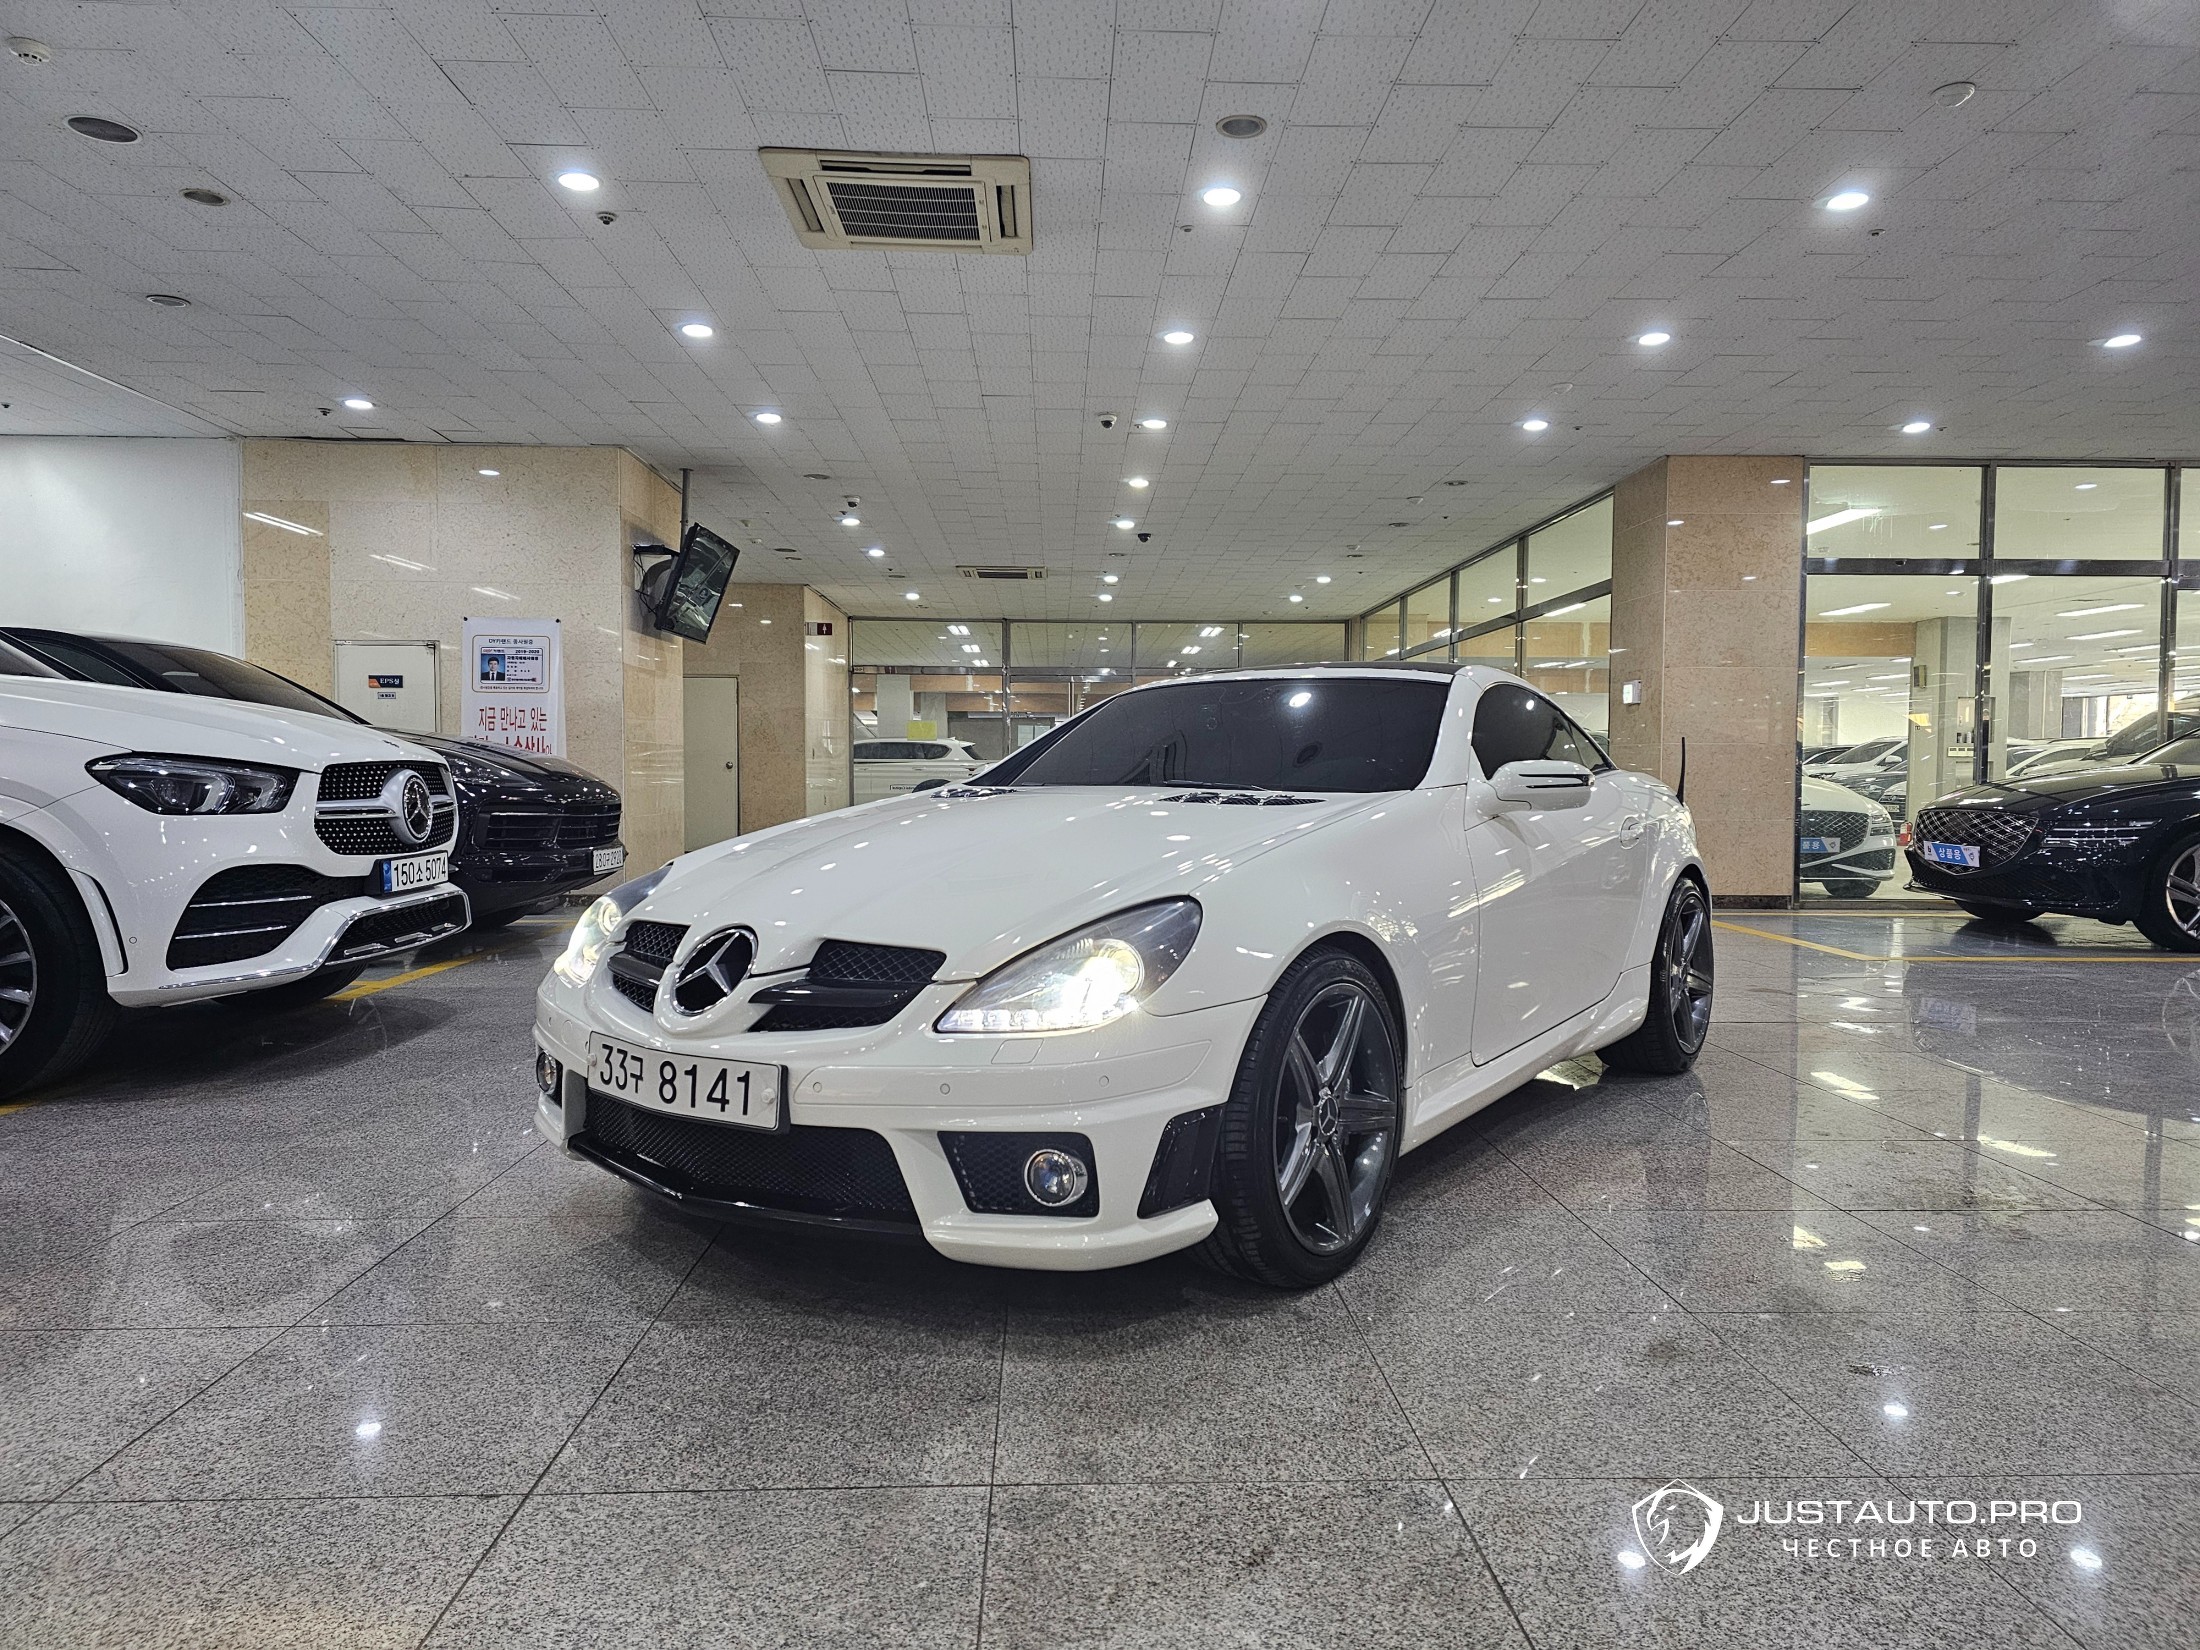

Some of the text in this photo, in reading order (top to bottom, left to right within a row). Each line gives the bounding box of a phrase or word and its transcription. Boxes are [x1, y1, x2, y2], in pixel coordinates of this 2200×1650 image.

[478, 705, 548, 732] 지금 만나고 있는
[1938, 846, 1962, 861] 상품용
[393, 856, 447, 887] 150소 5074
[599, 1043, 751, 1116] 33구 8141
